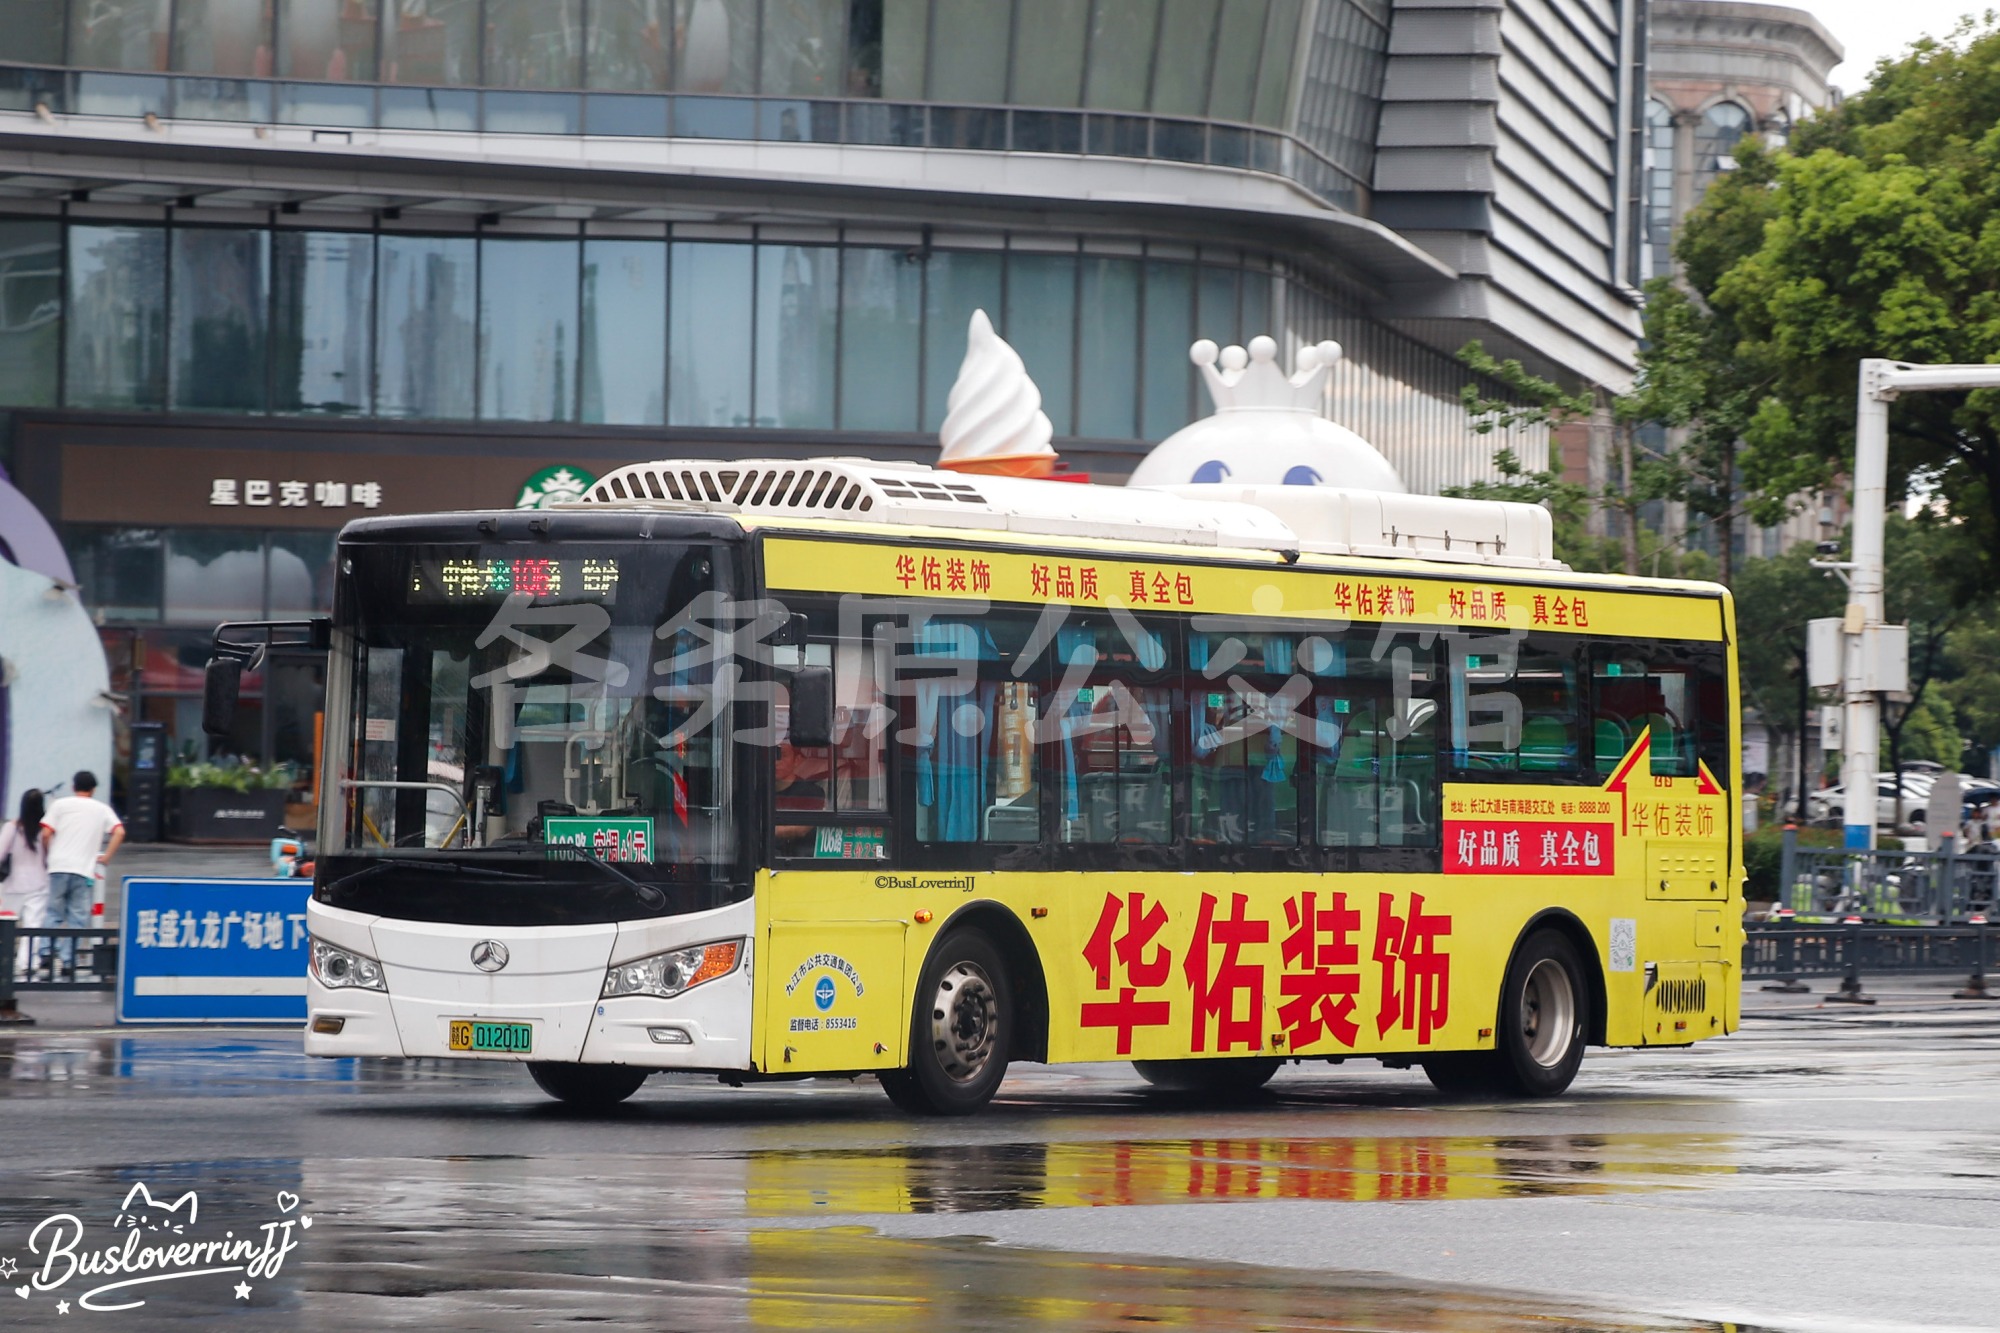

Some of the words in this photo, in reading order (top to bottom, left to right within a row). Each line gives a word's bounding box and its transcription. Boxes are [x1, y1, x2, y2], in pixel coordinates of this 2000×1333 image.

[210, 479, 382, 508] 星巴克咖啡
[896, 555, 991, 593] 华佑装饰
[1031, 563, 1098, 600] 好品质
[1129, 570, 1194, 605] 真全包
[1335, 582, 1415, 616] 华佑装饰
[1449, 588, 1507, 622] 好品质
[1533, 594, 1588, 627] 真全包
[1632, 802, 1713, 838] 华佑装饰
[1458, 829, 1520, 867] 好品质
[1540, 830, 1601, 867] 真全包
[136, 909, 309, 950] 联盛九龙广场地下
[785, 953, 864, 997] 九江市公共交通集团公司
[1080, 891, 1452, 1055] 华佑装饰
